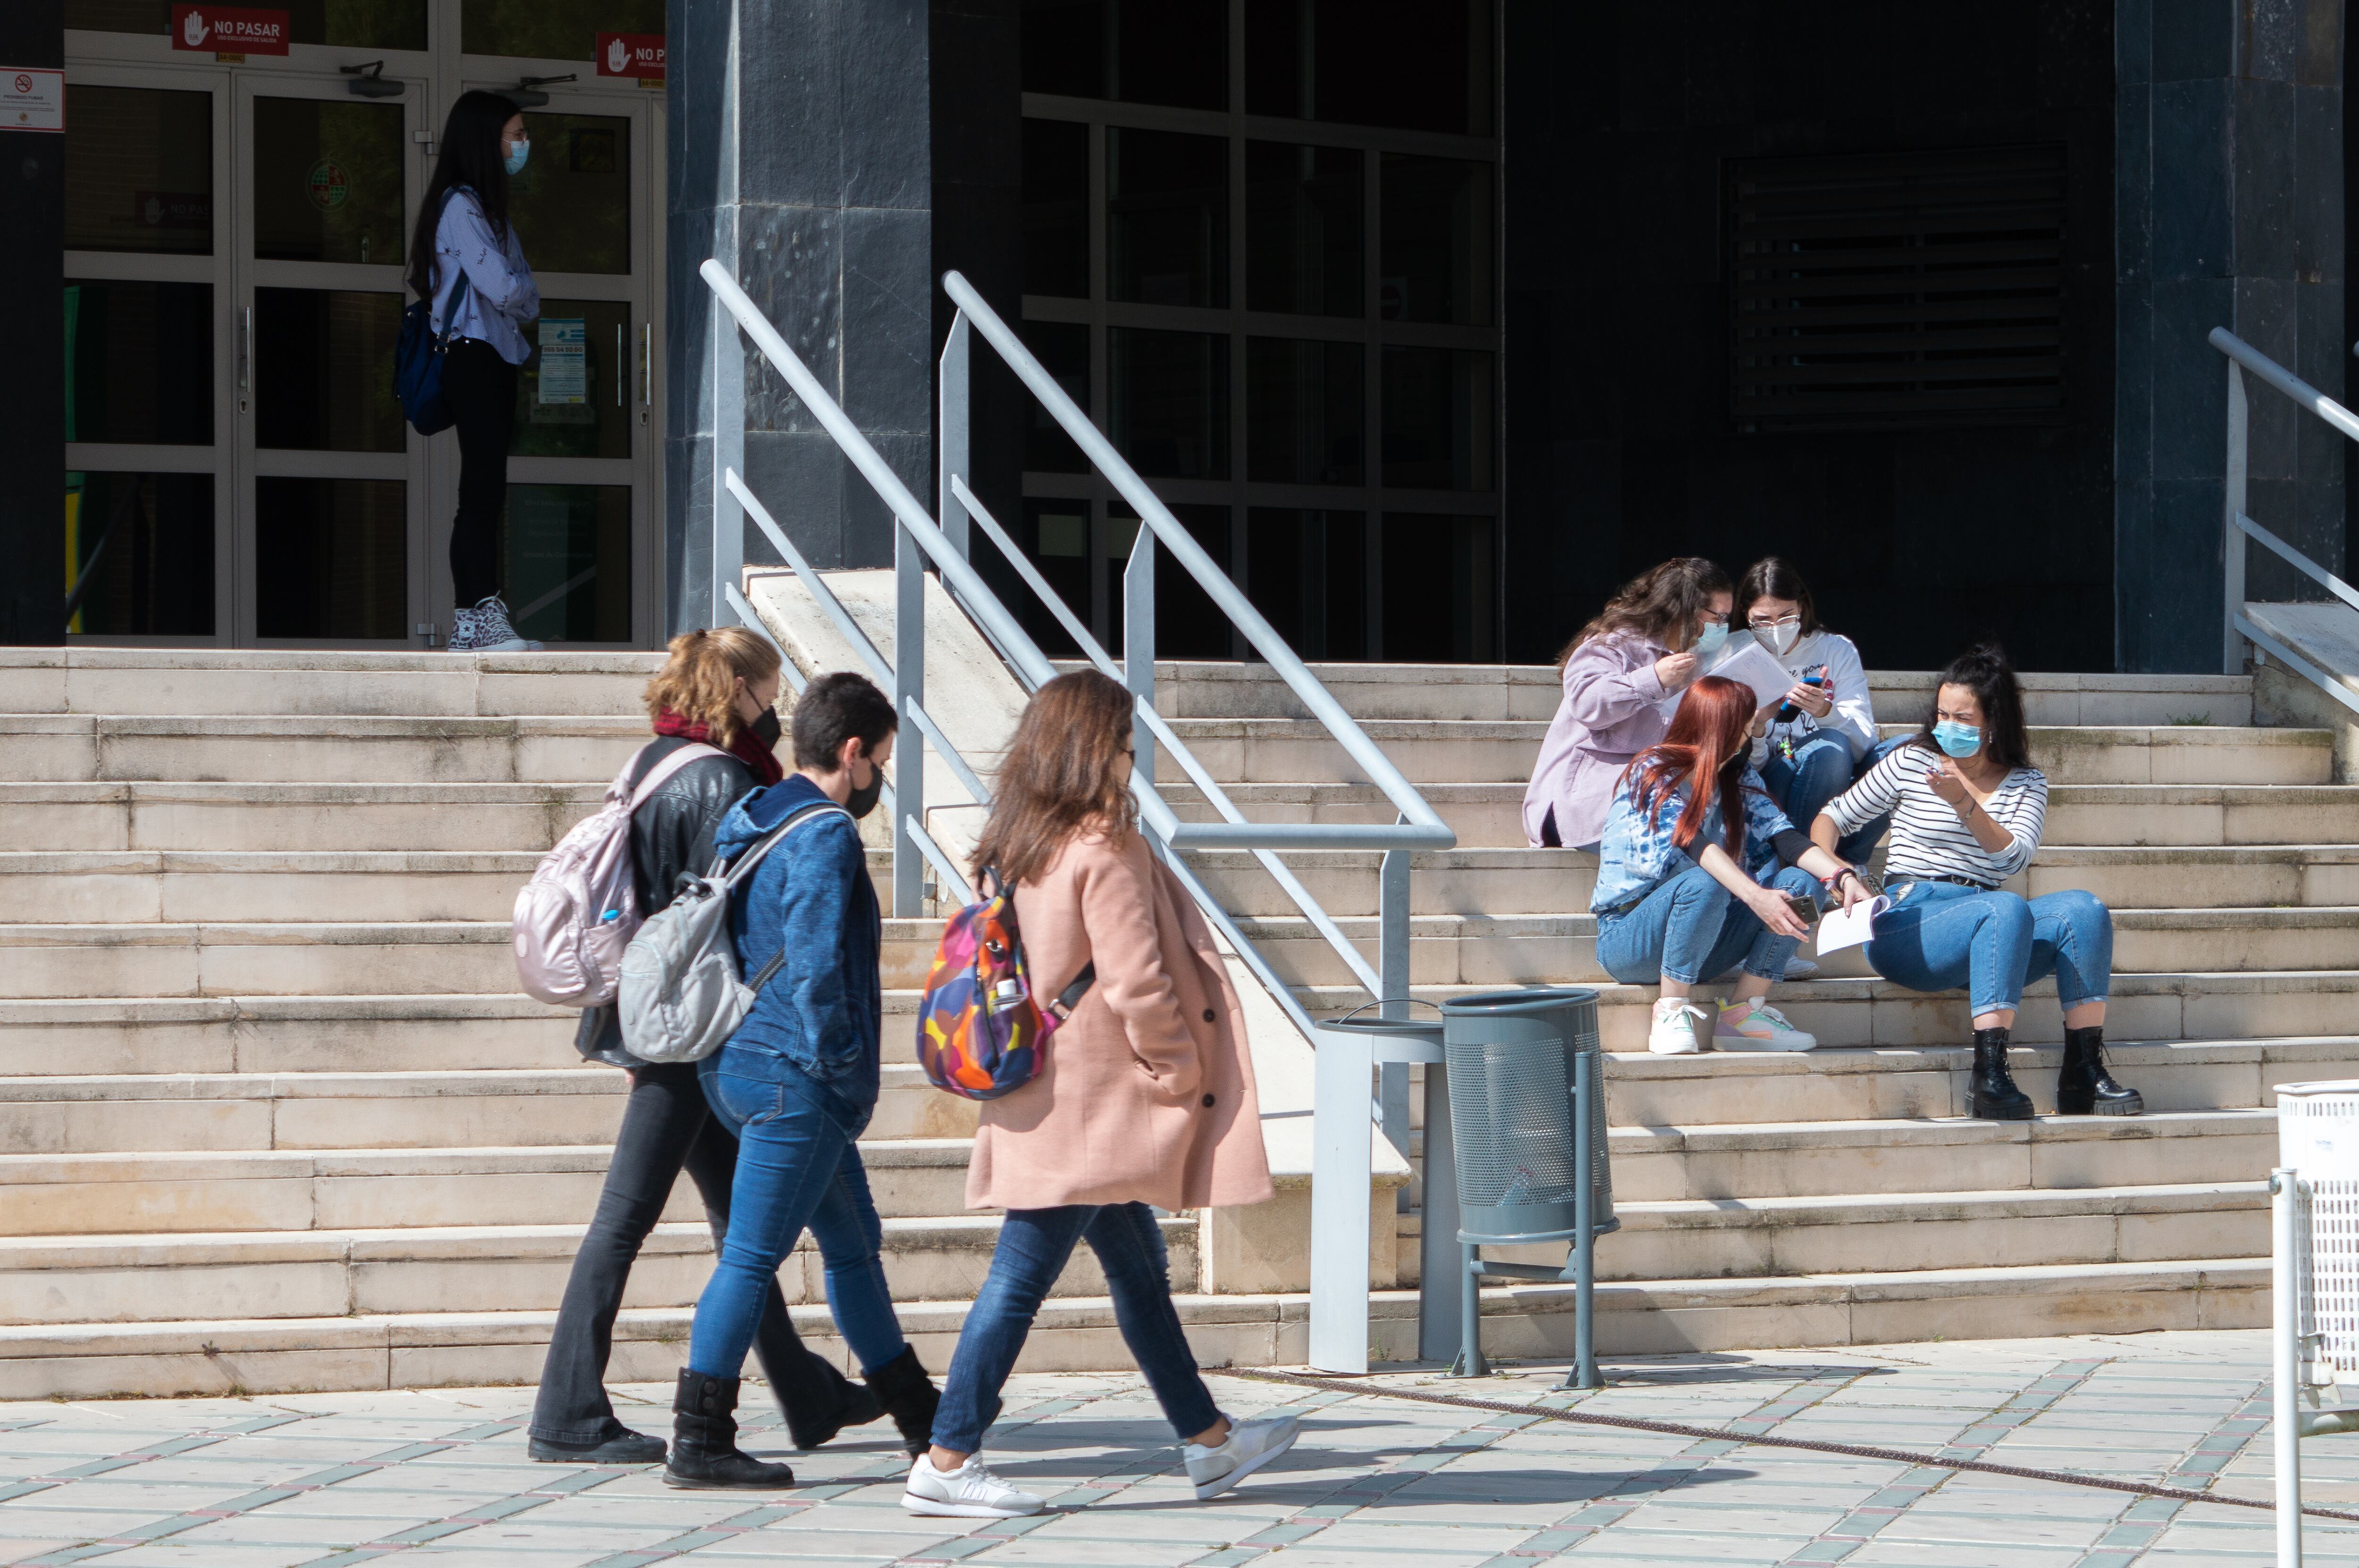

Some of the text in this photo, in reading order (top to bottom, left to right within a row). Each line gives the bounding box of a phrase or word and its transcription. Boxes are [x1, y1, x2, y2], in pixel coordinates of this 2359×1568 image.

[215, 21, 280, 37] NO PASAR
[636, 48, 664, 61] NO P
[170, 203, 208, 216] NO PAS
